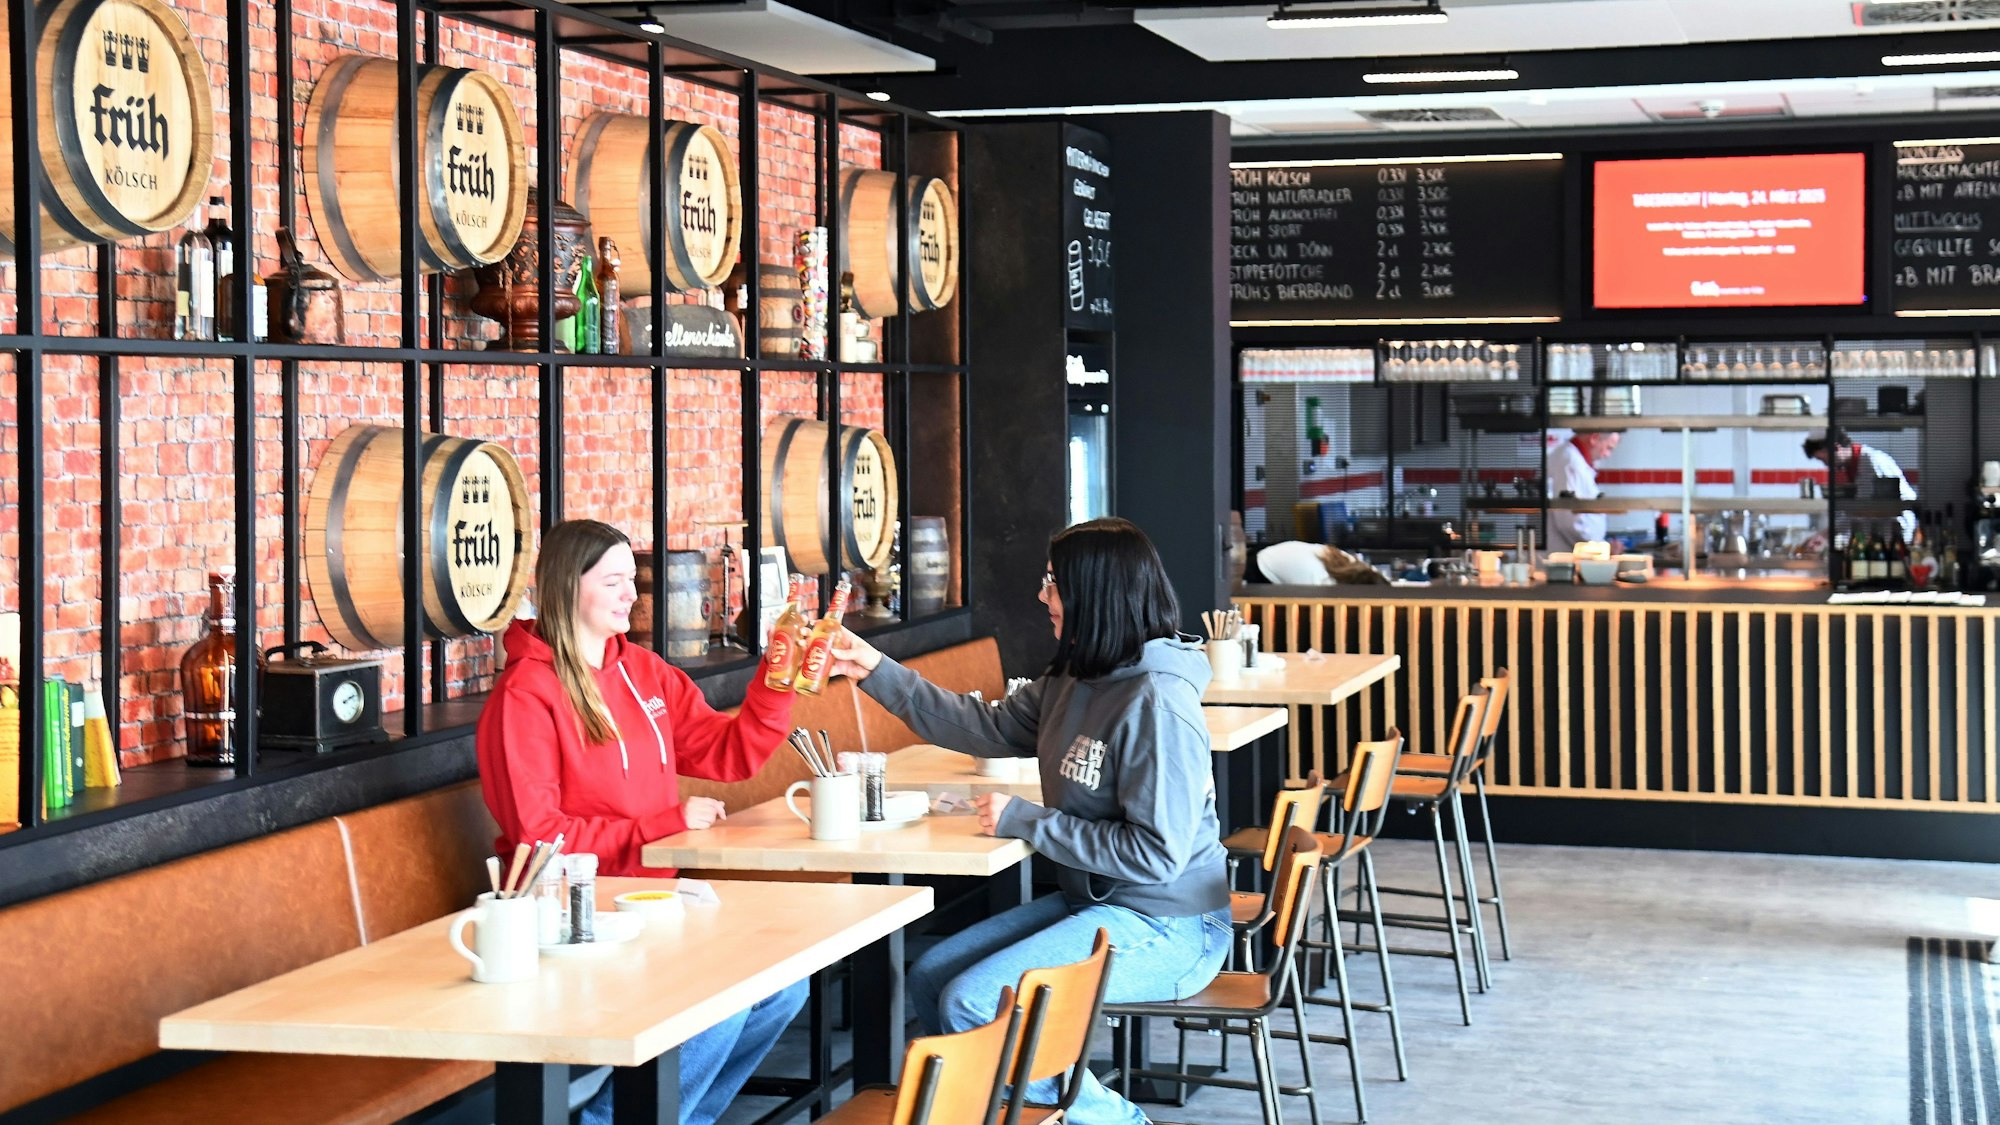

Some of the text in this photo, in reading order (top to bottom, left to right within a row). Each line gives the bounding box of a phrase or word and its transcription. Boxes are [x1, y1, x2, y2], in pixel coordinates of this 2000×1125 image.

[89, 83, 169, 161] früh
[104, 166, 158, 190] KÖLSCH
[447, 145, 495, 205] früh
[1919, 182, 1944, 200] MIT
[455, 210, 488, 229] KÖLSCH
[682, 190, 716, 237] früh
[1894, 211, 1981, 227] MITTWOCHS
[1267, 243, 1288, 259] UN
[1926, 265, 1956, 286] MIT
[1277, 282, 1353, 300] BIERBRAND
[453, 518, 500, 569] früh
[460, 582, 493, 598] KÖLSCH
[1059, 755, 1101, 791] früh
